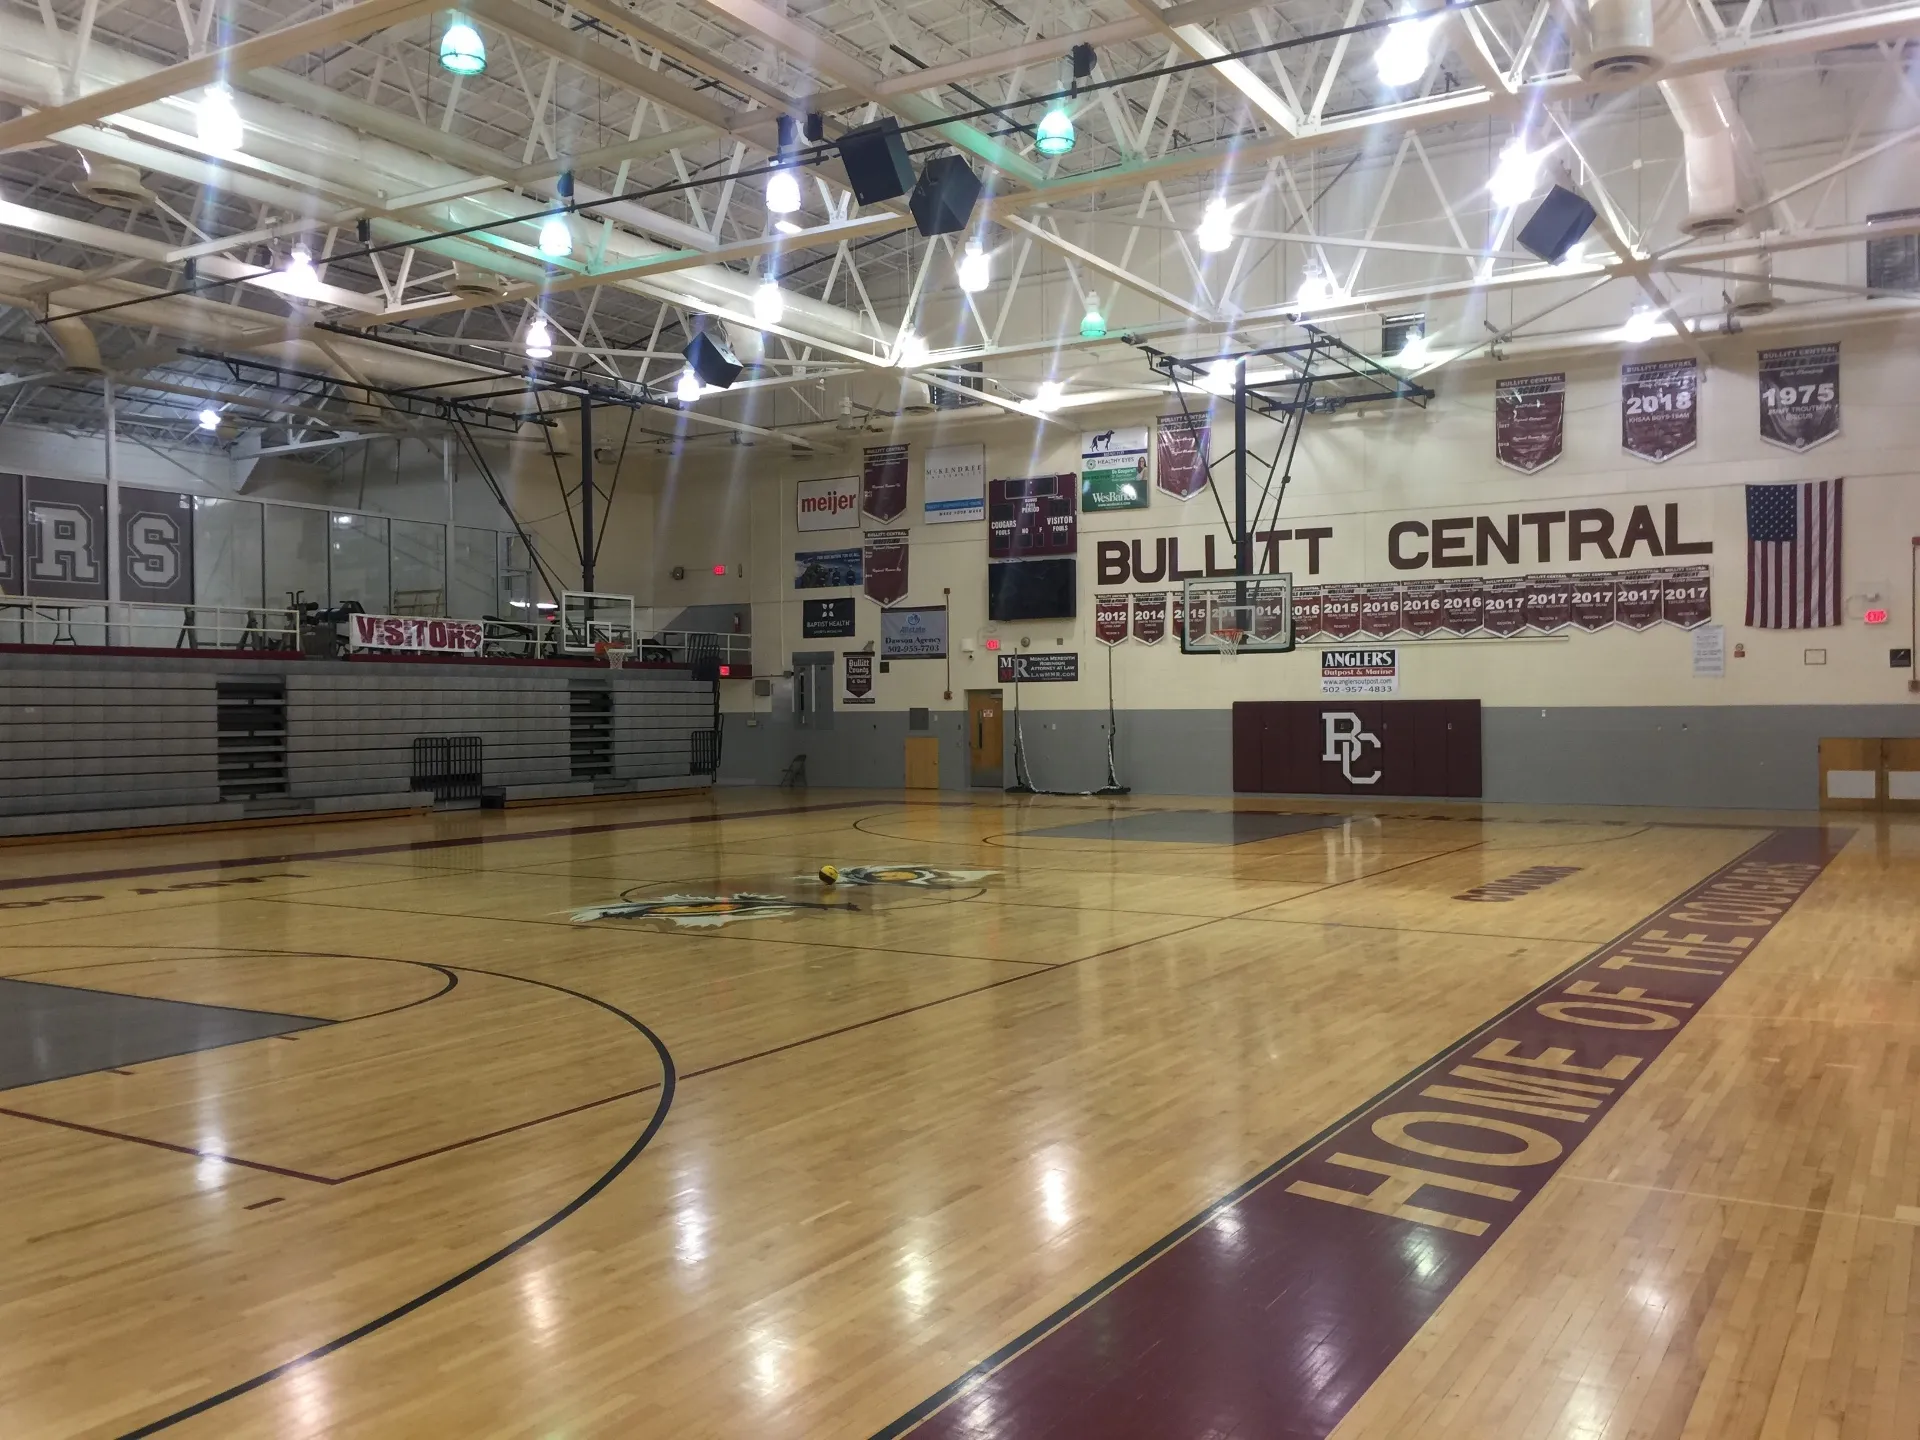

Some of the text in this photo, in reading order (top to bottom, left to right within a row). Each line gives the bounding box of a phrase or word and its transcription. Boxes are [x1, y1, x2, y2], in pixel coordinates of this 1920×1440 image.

[1764, 346, 1836, 358] BULLITT CENTRAL
[1627, 361, 1692, 372] BULLITT CENTRAL
[1762, 382, 1834, 406] 1975
[1626, 392, 1692, 414] 2018
[802, 491, 856, 515] meijer
[1092, 492, 1136, 503] WesBanco
[992, 520, 1016, 529] COUGARS
[1047, 516, 1073, 525] VISITOR
[1098, 503, 1713, 585] BULLITT CENTRAL
[1527, 593, 1568, 605] 2017
[1572, 592, 1612, 603] 2017
[1618, 590, 1660, 602] 2017
[1665, 587, 1708, 600] 2017
[1324, 603, 1358, 613] 2015
[1363, 602, 1398, 613] 2016
[1403, 600, 1440, 610] 2016
[1444, 597, 1481, 609] 2016
[1486, 598, 1524, 610] 2017
[1135, 610, 1165, 620] 2014
[1256, 606, 1281, 616] 014
[1292, 605, 1320, 615] 016
[1866, 611, 1886, 621] EXIT
[1097, 612, 1126, 621] 2012
[356, 616, 482, 649] VISITORS
[1325, 652, 1392, 667] ANGLERS
[1000, 657, 1030, 678] M R
[1322, 712, 1382, 784] BC
[1285, 862, 1821, 1237] HOME OF THE COUGARS
